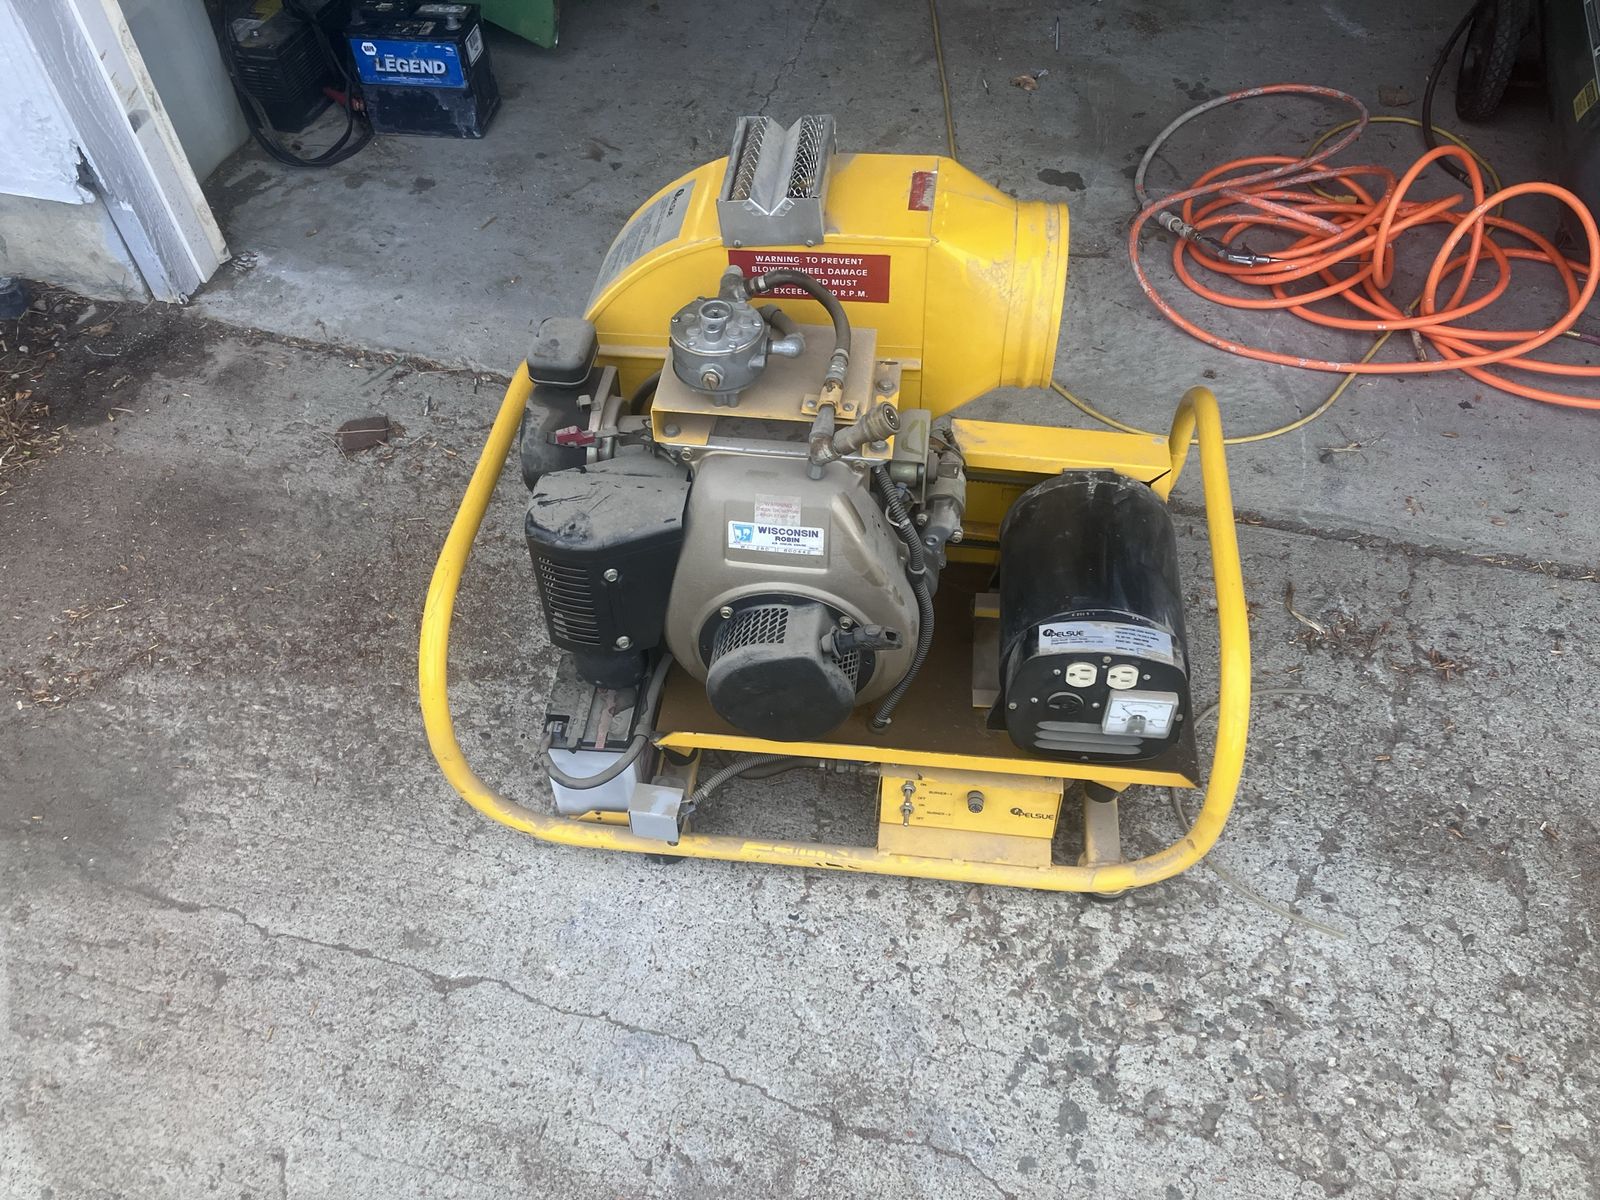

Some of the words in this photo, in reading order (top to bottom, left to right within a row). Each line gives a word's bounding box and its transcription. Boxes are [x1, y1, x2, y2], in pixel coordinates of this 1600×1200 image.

[375, 57, 446, 75] LEGEND
[755, 255, 803, 264] WARNING:
[821, 257, 863, 265] PREVENT
[828, 268, 868, 276] DAMAGE
[840, 290, 869, 298] R.P.M.
[758, 526, 819, 538] WISCONSIN
